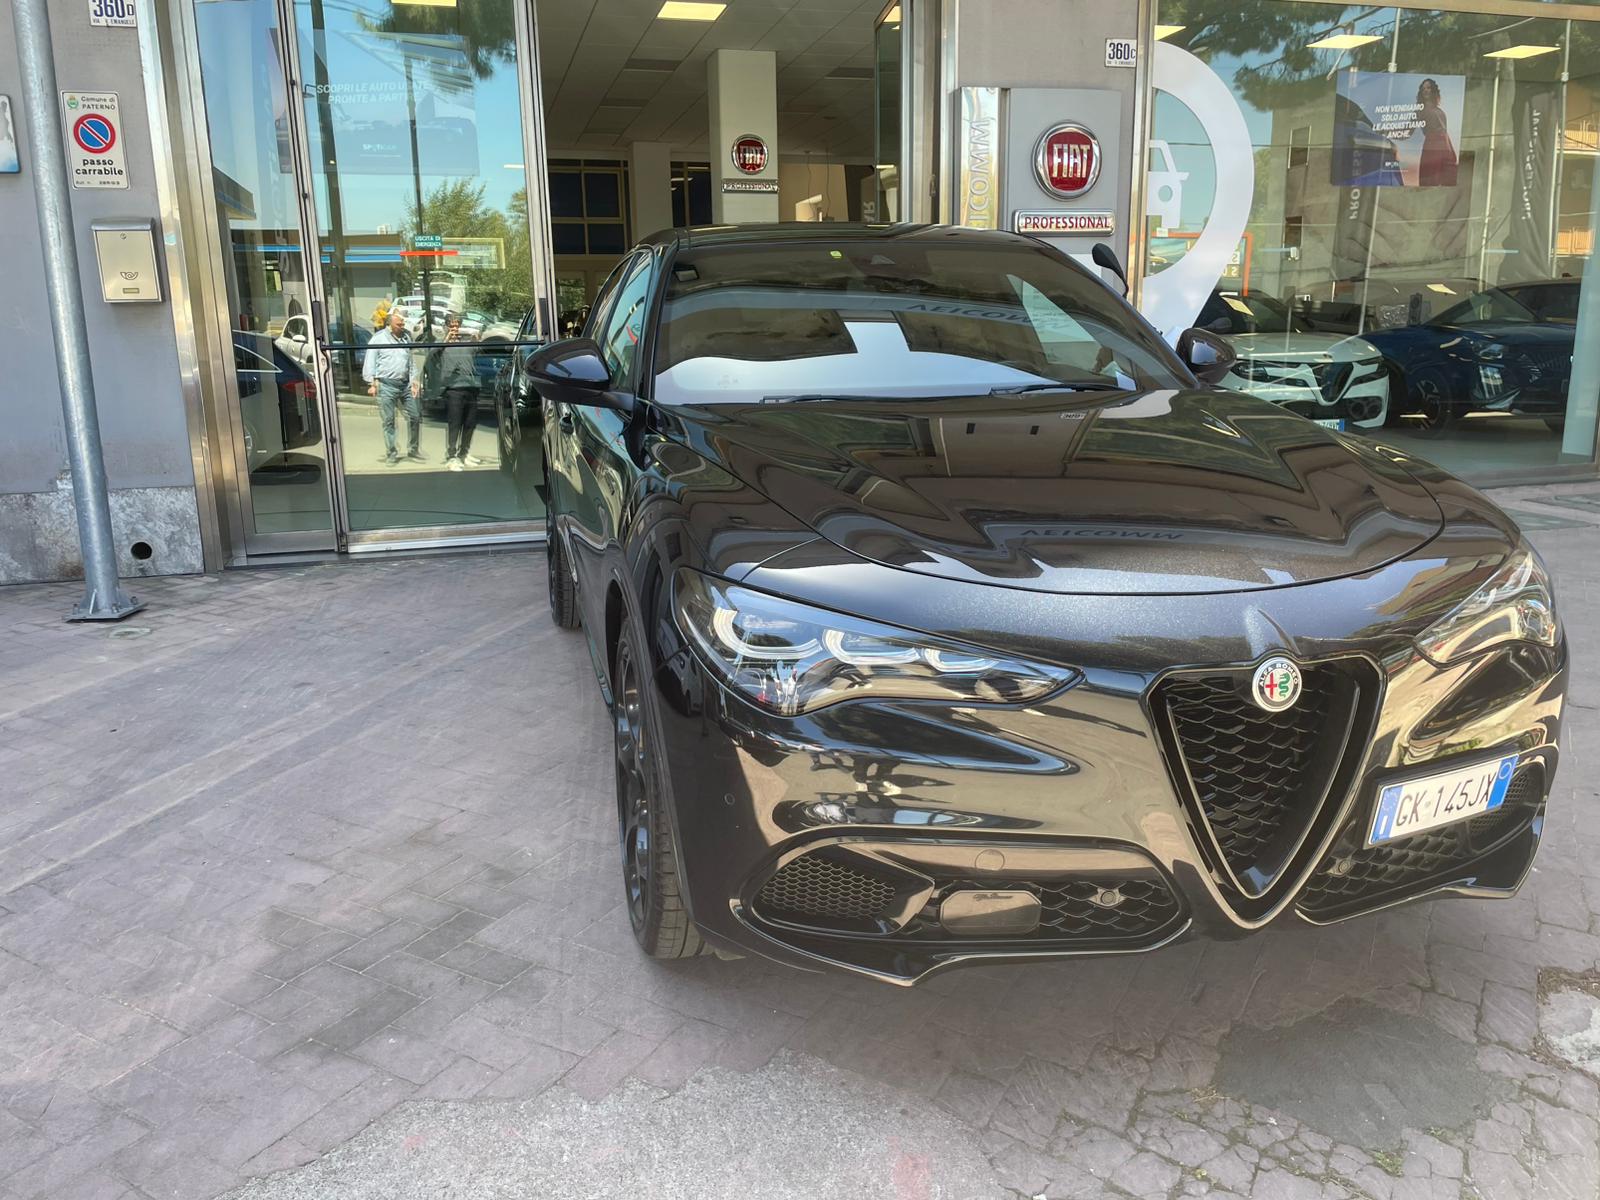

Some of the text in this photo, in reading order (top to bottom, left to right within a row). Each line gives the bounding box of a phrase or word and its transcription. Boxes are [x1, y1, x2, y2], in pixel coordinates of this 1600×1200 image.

[316, 82, 355, 94] SCOPRI
[328, 94, 368, 105] PRONTE
[1375, 103, 1425, 113] NON VENDIAMO
[1381, 114, 1399, 122] SOLO
[1382, 120, 1427, 130] ACQUISTIAMO
[82, 159, 114, 167] passo
[1051, 143, 1091, 179] FIAT
[75, 167, 124, 176] carrabile
[1024, 216, 1111, 230] PROFESSIONAL
[1395, 771, 1498, 828] GK 145JX
